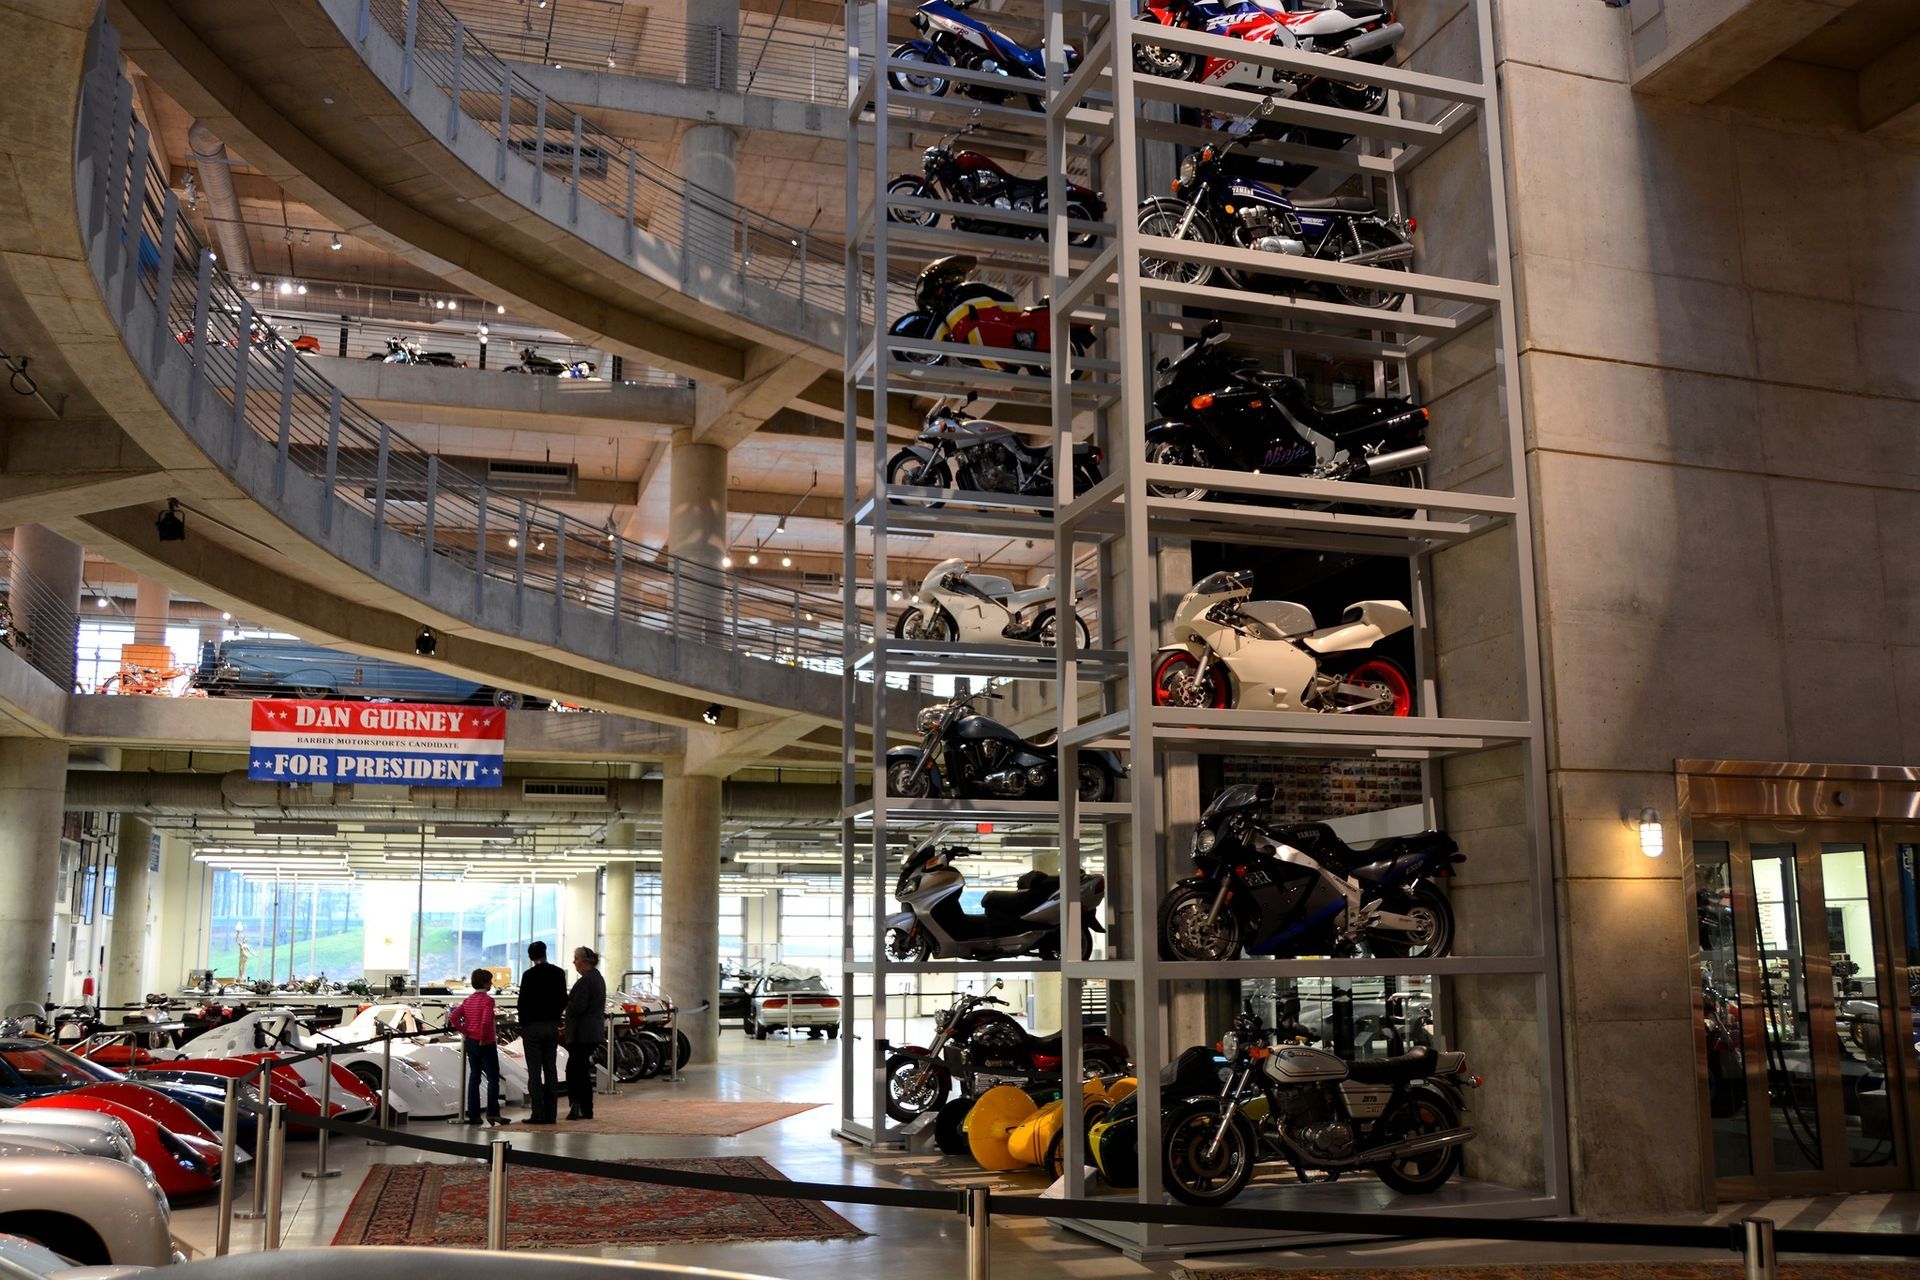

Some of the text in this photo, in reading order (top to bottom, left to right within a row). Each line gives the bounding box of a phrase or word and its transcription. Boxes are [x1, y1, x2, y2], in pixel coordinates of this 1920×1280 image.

[1232, 186, 1254, 196] YAMAHA
[1263, 442, 1309, 466] Ninja
[295, 706, 464, 732] DAN GURNEY
[336, 738, 406, 748] MOTORSPORTS
[408, 741, 459, 749] CANDIDATE
[273, 754, 479, 781] FOR PRESIDENT
